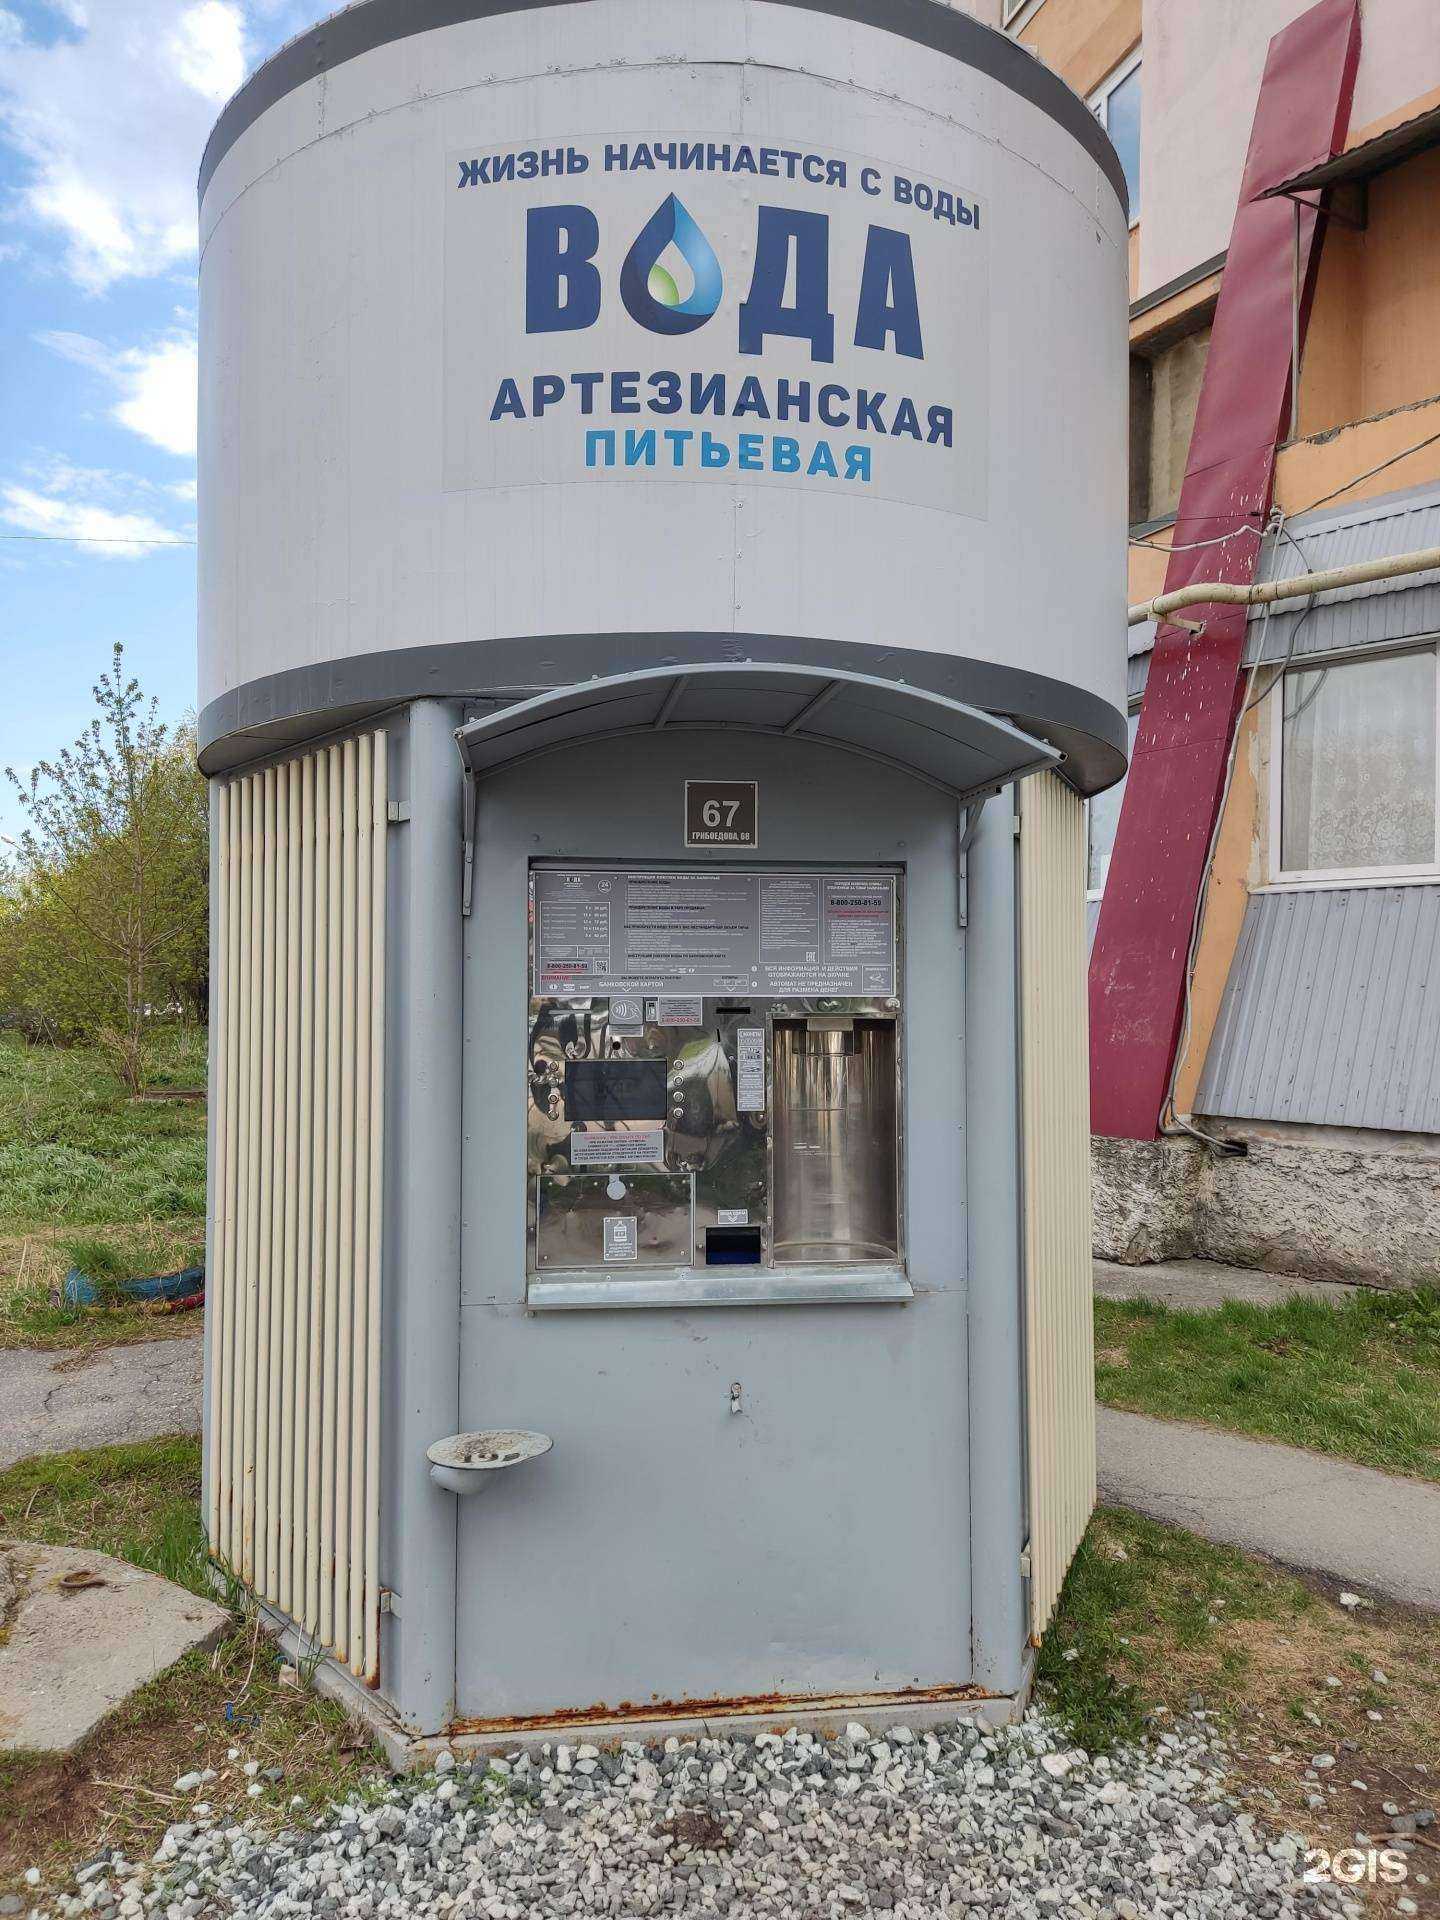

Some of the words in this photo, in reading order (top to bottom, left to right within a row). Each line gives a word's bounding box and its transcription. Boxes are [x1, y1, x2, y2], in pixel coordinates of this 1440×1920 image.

[457, 147, 589, 189] ЖИЗНЬ
[604, 142, 847, 189] НАЧИНАЕТСЯ
[860, 168, 882, 196] С
[894, 175, 981, 231] ВОДЫ
[489, 370, 954, 448] АРТЕЗИАНСКАЯ
[585, 428, 872, 482] ПИТЬЕВАЯ
[702, 799, 740, 827] 67
